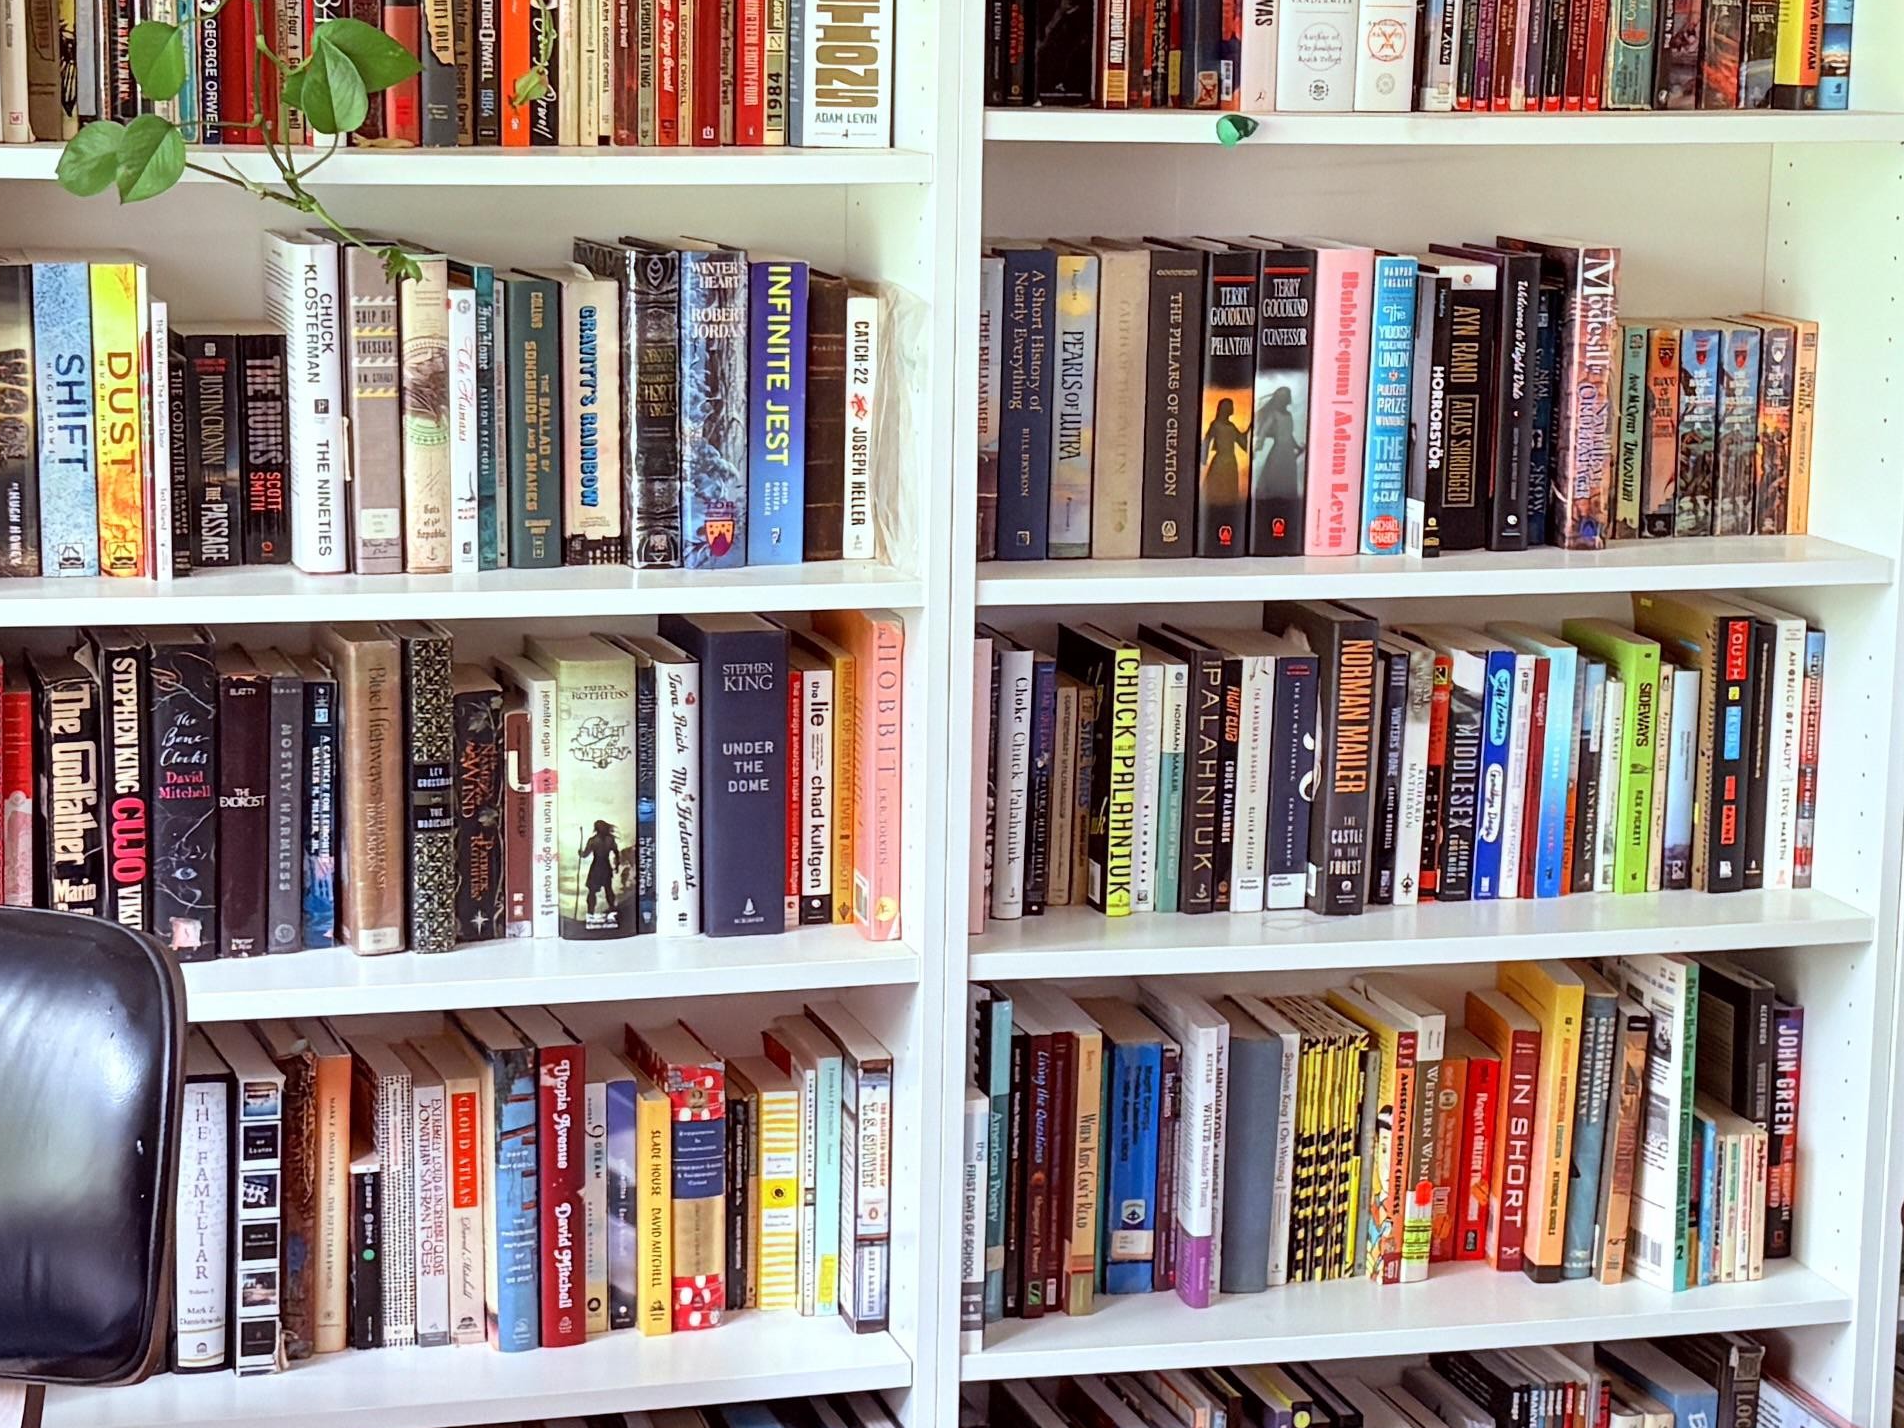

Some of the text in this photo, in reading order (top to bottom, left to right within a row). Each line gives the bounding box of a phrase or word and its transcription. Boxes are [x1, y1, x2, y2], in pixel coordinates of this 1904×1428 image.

[205, 18, 220, 139] GEORGE ORWELL
[768, 72, 783, 126] 1984
[815, 111, 878, 125] ADAM LEVIN
[303, 264, 321, 384] KLOSTERMAN
[319, 293, 334, 354] CHUCK
[699, 275, 739, 289] HEART
[765, 265, 792, 467] INFINITE JEST
[1451, 305, 1481, 384] AYN RAND
[55, 354, 88, 473] SHIFT
[107, 352, 136, 474] DUST
[850, 320, 870, 527] CATCH-22 JOSEPH HELLER
[1428, 366, 1445, 470] HORRORSTÖR
[316, 441, 332, 558] THE NINETIES
[723, 663, 773, 675] STEPHEN
[724, 675, 773, 692] KING
[723, 741, 774, 756] UNDER
[1334, 640, 1375, 794] NORMAN MAILER
[1635, 683, 1653, 747] SIDEWAYS
[159, 784, 212, 800] Mitchell
[166, 771, 205, 785] David
[728, 779, 770, 793] DOME
[734, 761, 764, 774] THE
[1007, 676, 1029, 867] Choke Chuck Palahniuk
[1108, 658, 1140, 895] CHUCK PALAHNIUK
[1448, 724, 1481, 828] MIDDLESEX
[112, 797, 146, 883] CUJO
[1773, 1025, 1799, 1135] JOHN GREEN
[453, 1096, 471, 1205] CLOUD ATLAS
[650, 1130, 661, 1196] SLADE HOUSE
[1504, 1073, 1531, 1229] IN SHORT
[650, 1207, 661, 1288] DAVID MITCHELL
